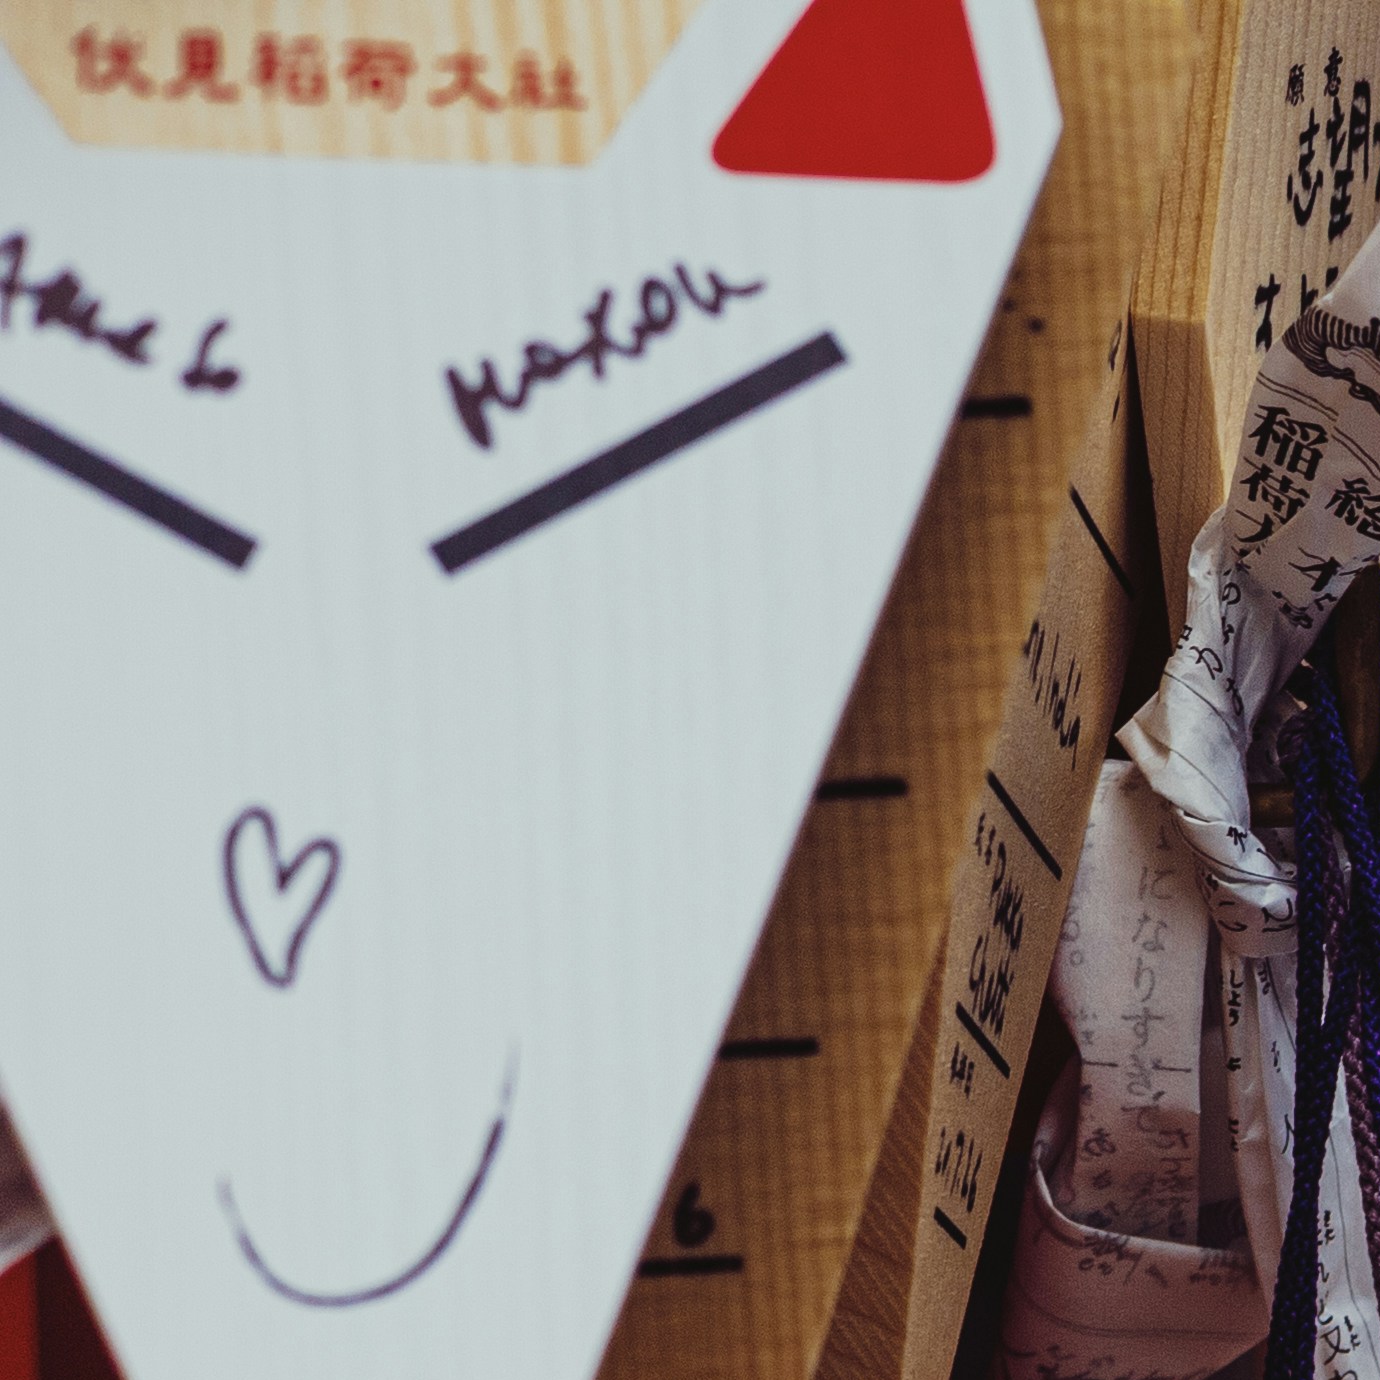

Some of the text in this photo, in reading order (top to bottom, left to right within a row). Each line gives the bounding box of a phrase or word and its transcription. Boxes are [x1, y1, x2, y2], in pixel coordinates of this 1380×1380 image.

[70, 22, 590, 112] 伏見稲荷大社
